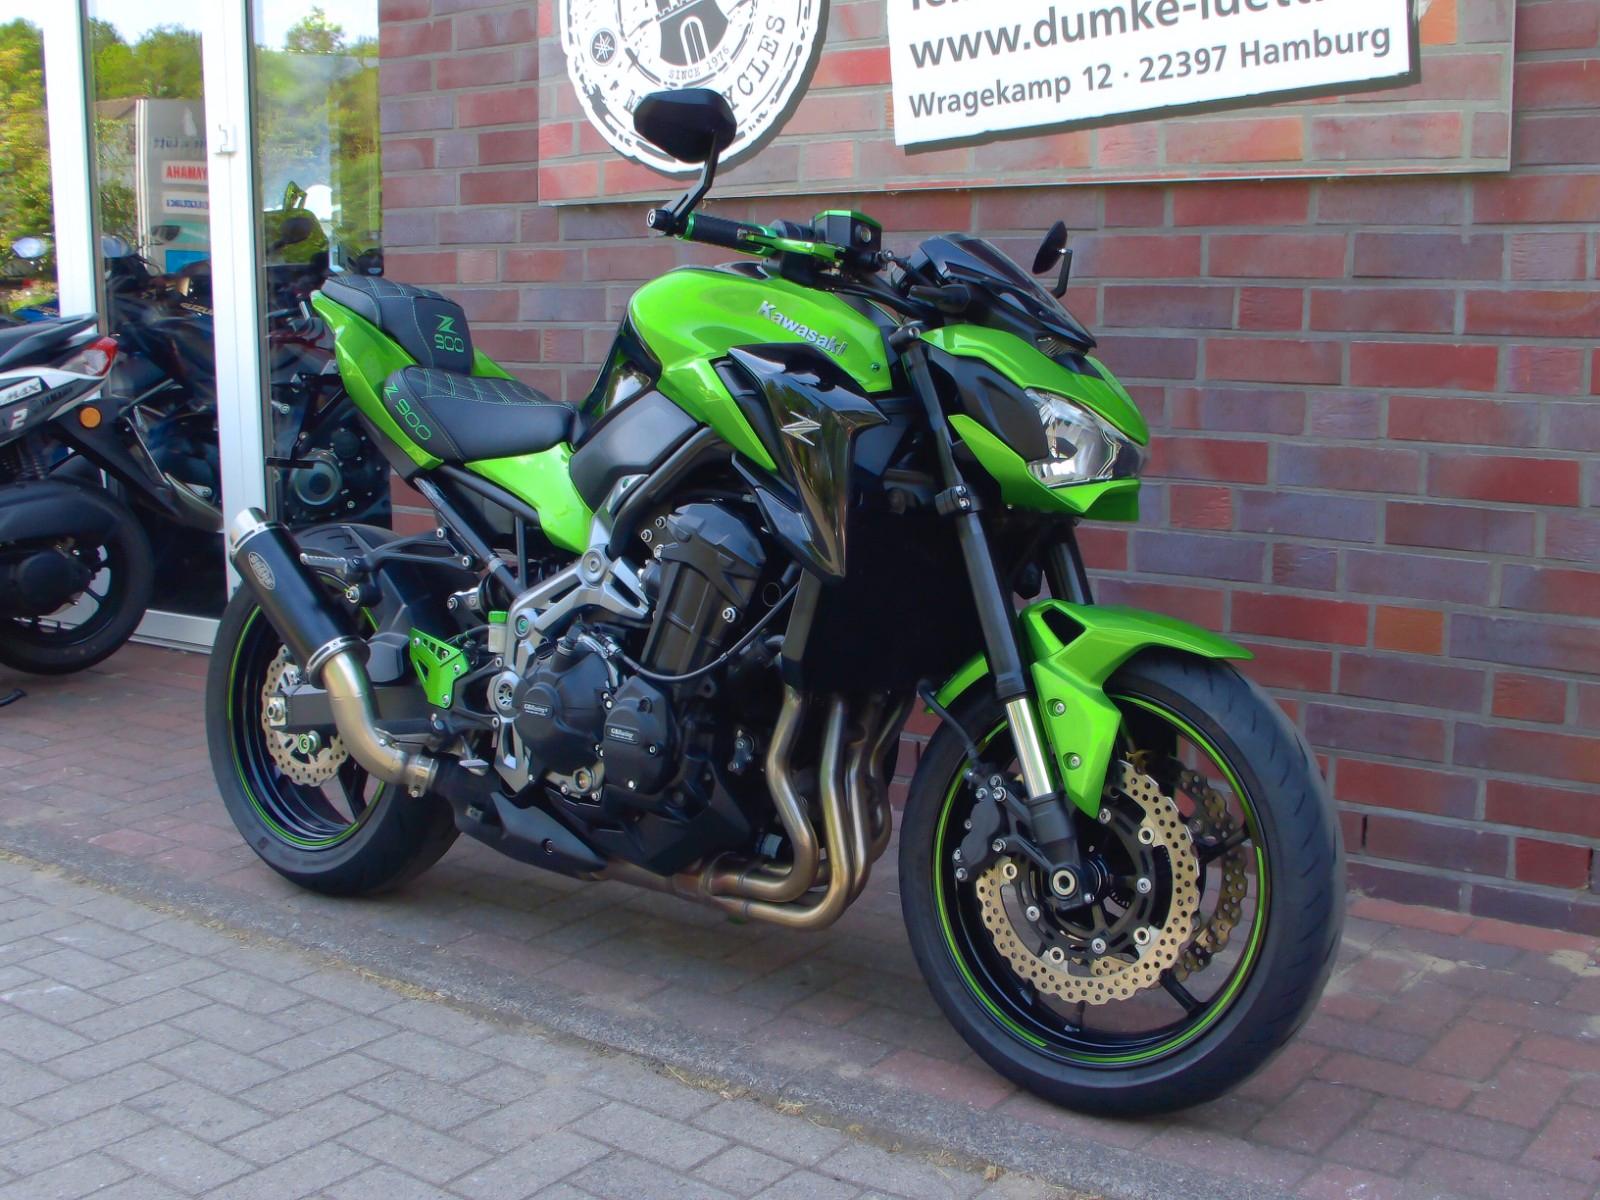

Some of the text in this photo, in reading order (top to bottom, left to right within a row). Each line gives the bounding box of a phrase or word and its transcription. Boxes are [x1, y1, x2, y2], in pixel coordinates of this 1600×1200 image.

[668, 67, 701, 81] SINCE
[909, 27, 1390, 118] Wragekamp 12 22397 Hamburg
[757, 300, 849, 357] Kawasaki
[394, 398, 432, 440] 900
